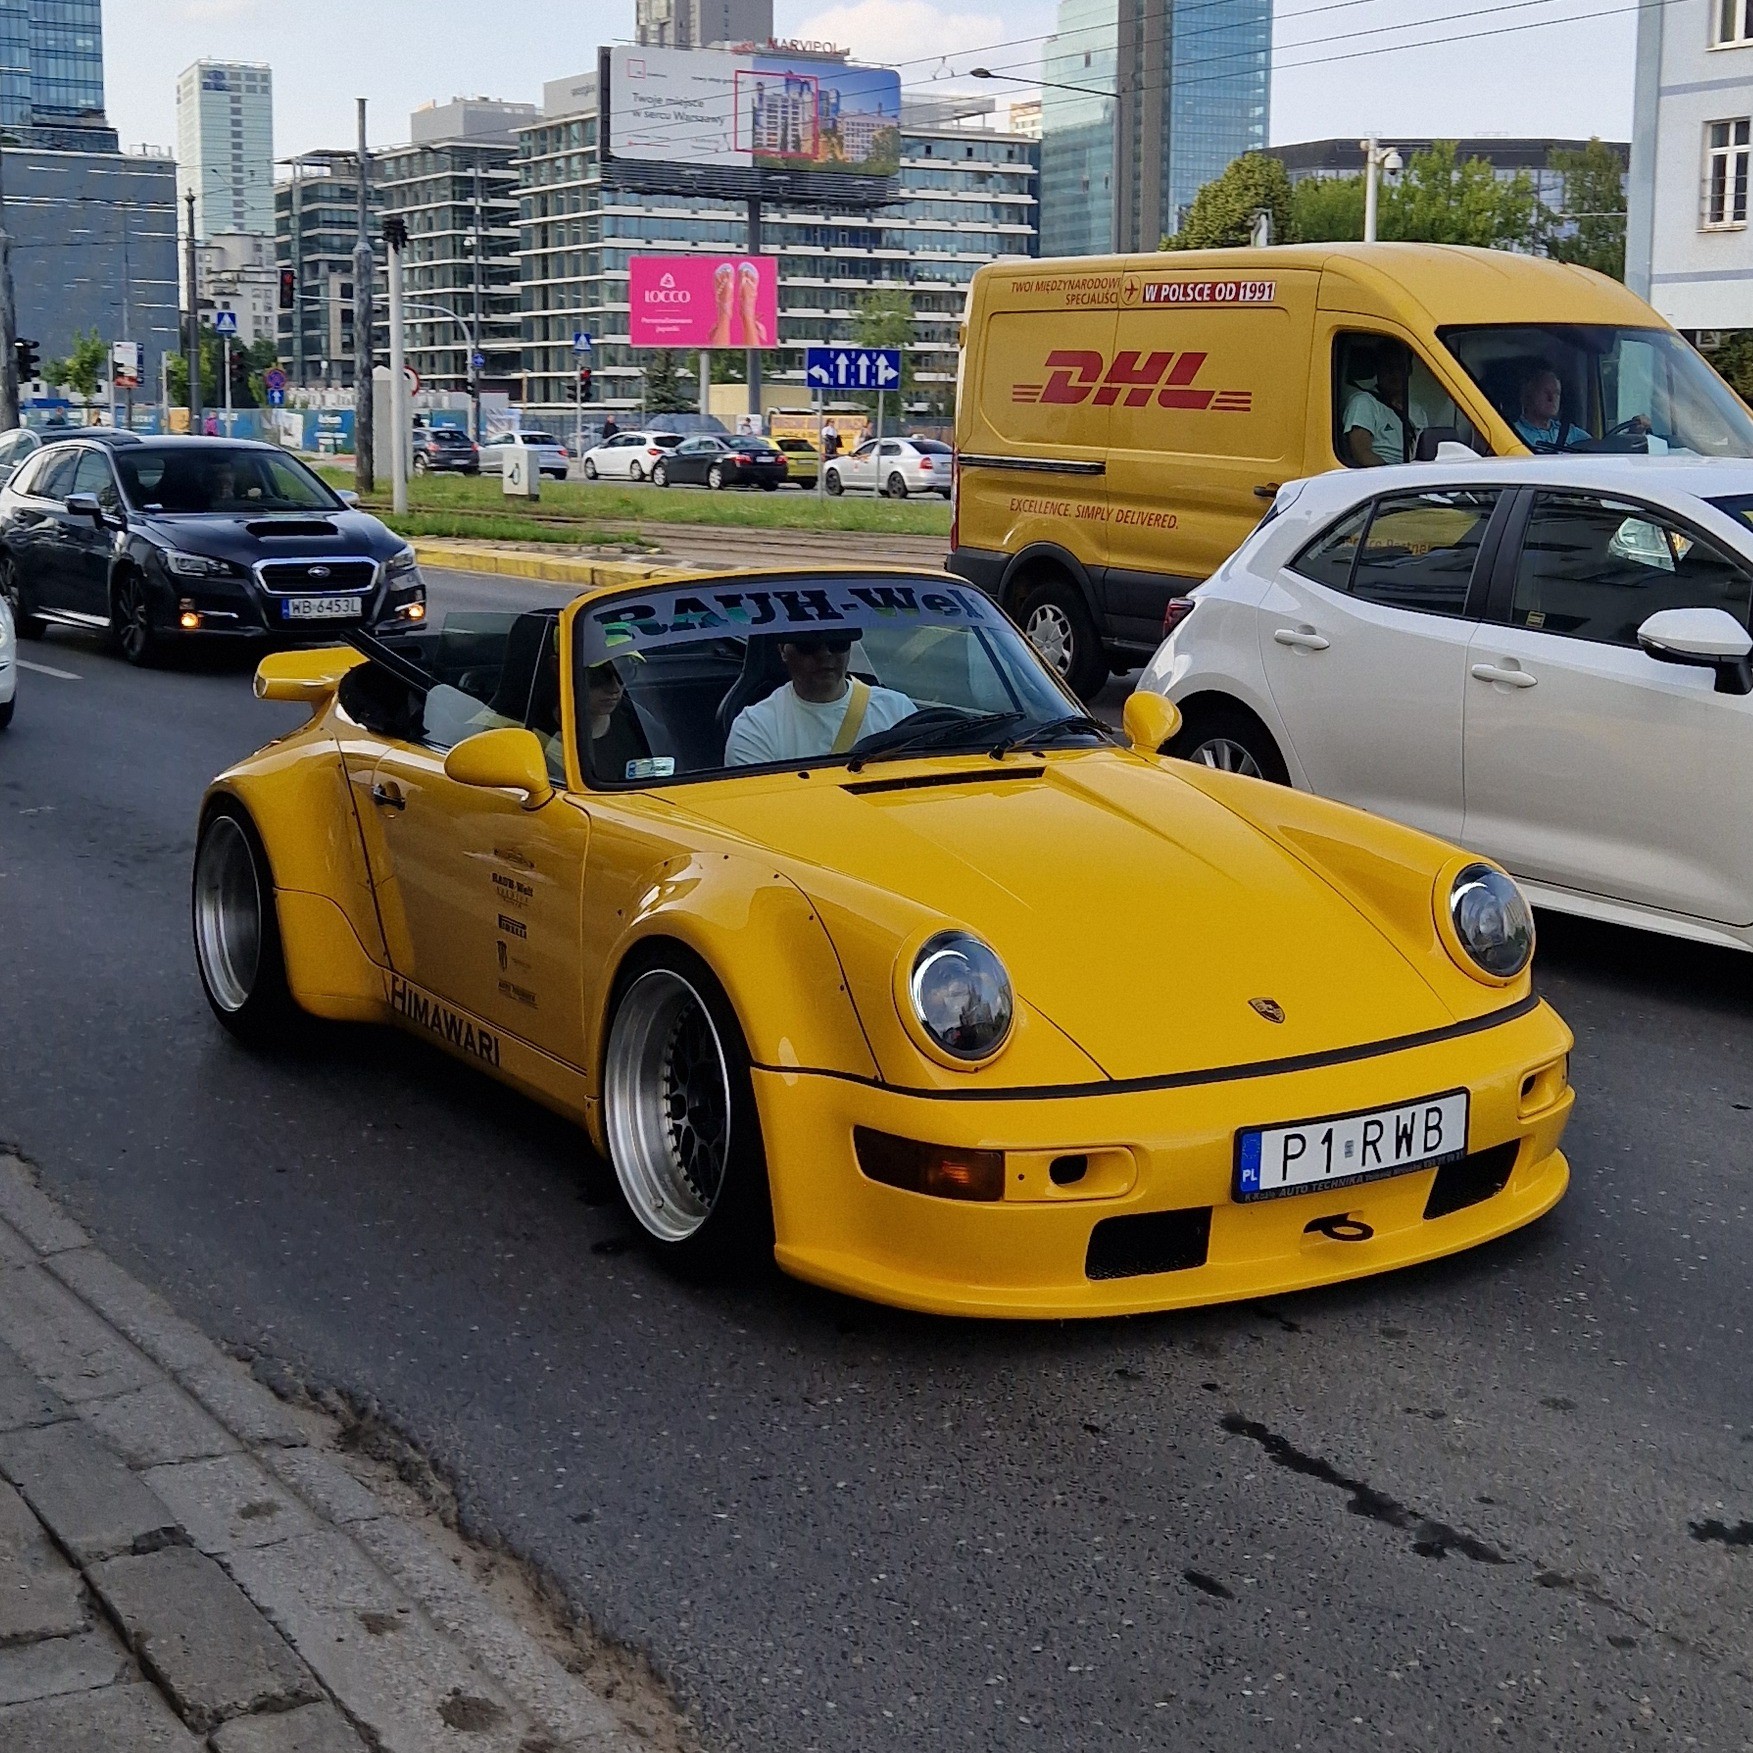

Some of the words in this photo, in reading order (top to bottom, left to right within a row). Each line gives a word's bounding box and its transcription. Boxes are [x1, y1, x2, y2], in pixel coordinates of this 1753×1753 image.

[632, 92, 664, 107] Twoje
[644, 111, 672, 119] sercu
[673, 111, 724, 126] Warszawy
[1035, 277, 1121, 294] MIĘDZYNARODOWI
[1145, 284, 1158, 301] W
[1160, 283, 1212, 301] POLSCE
[1215, 283, 1236, 300] OD
[1241, 282, 1273, 300] 1991
[1066, 290, 1118, 305] SPECJALIŚCI
[1039, 350, 1216, 409] DHL
[1010, 498, 1071, 517] EXCELLENCE.
[1075, 505, 1113, 521] SIMPLY
[1115, 510, 1178, 530] DELIVERED.
[291, 599, 313, 614] WB
[316, 598, 360, 613] 6453L
[594, 587, 985, 648] RAUH-Wel
[391, 973, 500, 1068] HIMAWARI
[1282, 1127, 1333, 1181] P1
[1361, 1106, 1443, 1166] RWB
[1242, 1168, 1258, 1182] PL
[1279, 1184, 1309, 1197] AUTO
[1312, 1175, 1364, 1193] TECHNIKA
